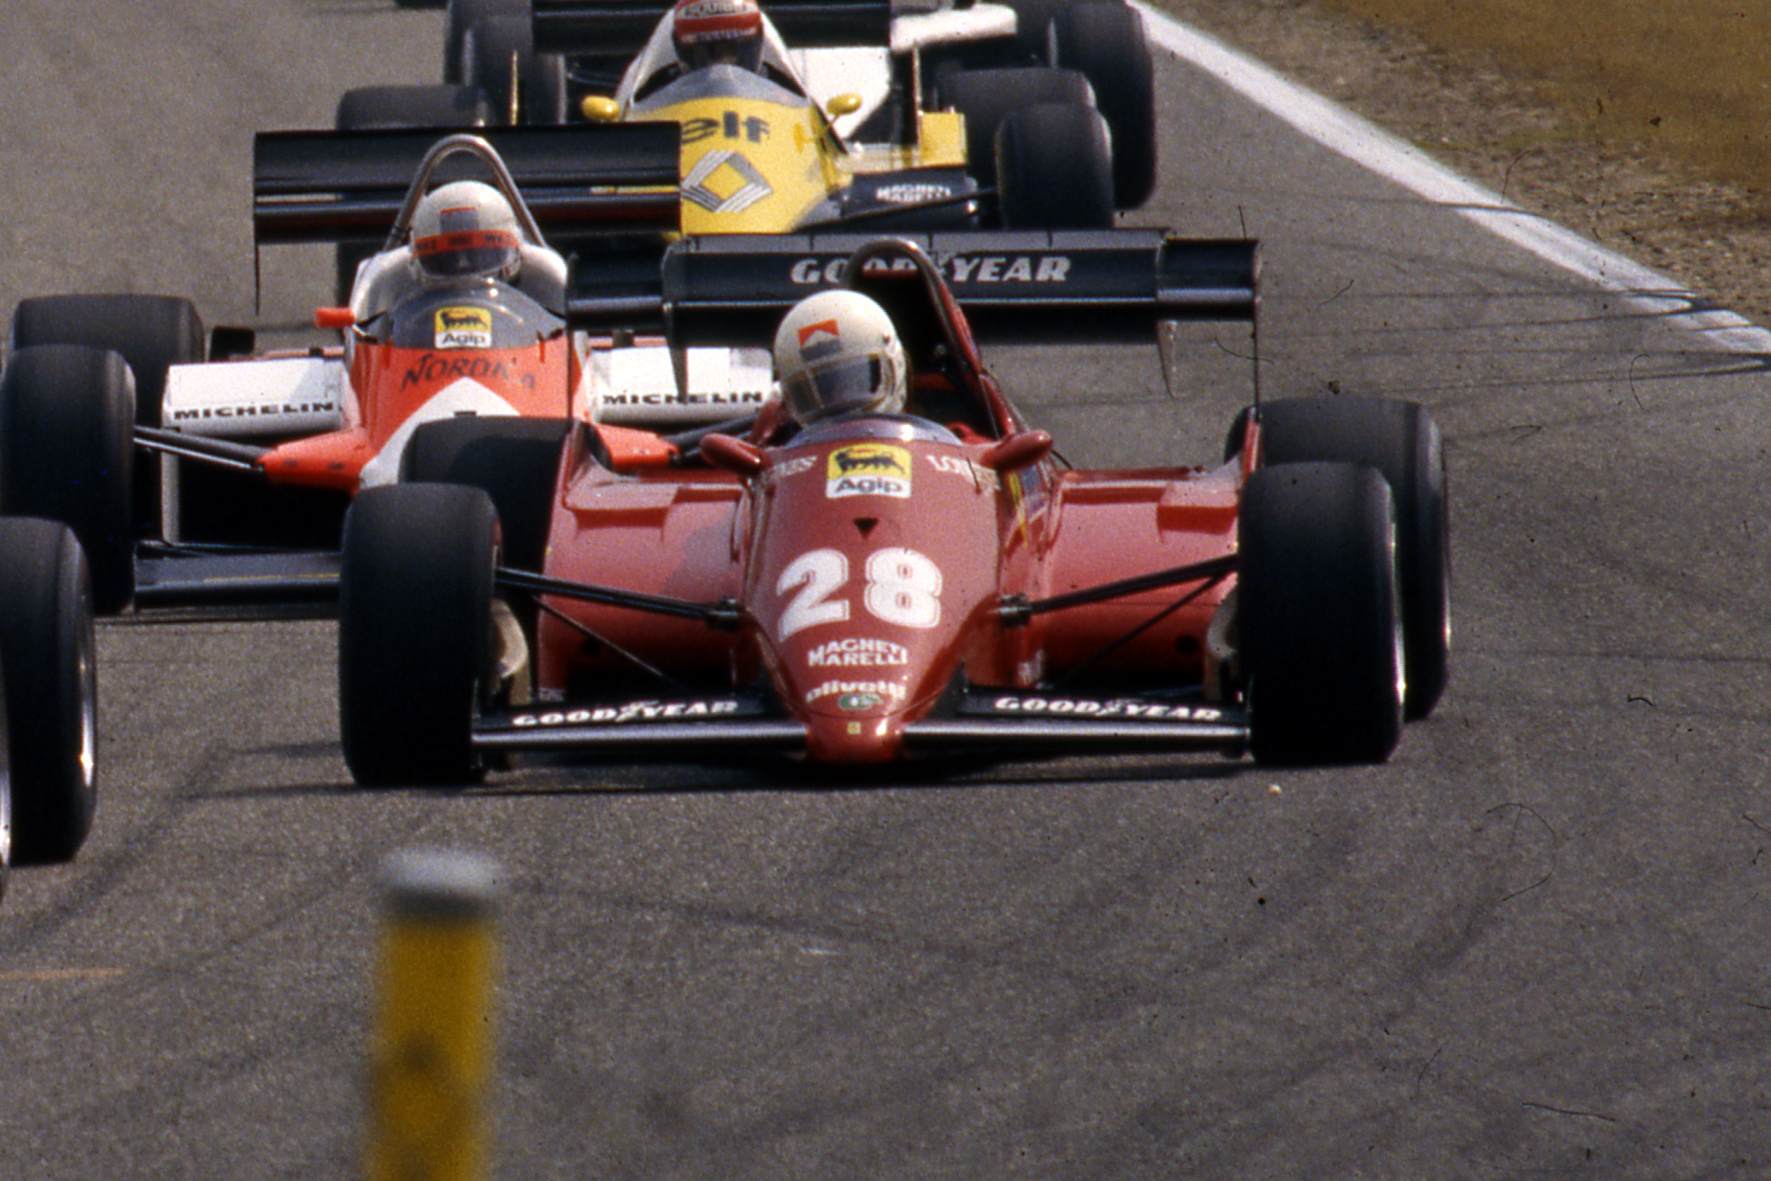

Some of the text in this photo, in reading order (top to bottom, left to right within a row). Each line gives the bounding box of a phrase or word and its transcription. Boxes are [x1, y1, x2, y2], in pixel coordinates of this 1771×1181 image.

[680, 110, 771, 144] elf
[442, 332, 486, 345] Agip
[173, 391, 763, 420] MICHELIN MICHELIN
[834, 477, 904, 496] Agip
[776, 547, 944, 642] 28
[511, 696, 1222, 726] GOODYEAR GOODYEAR
